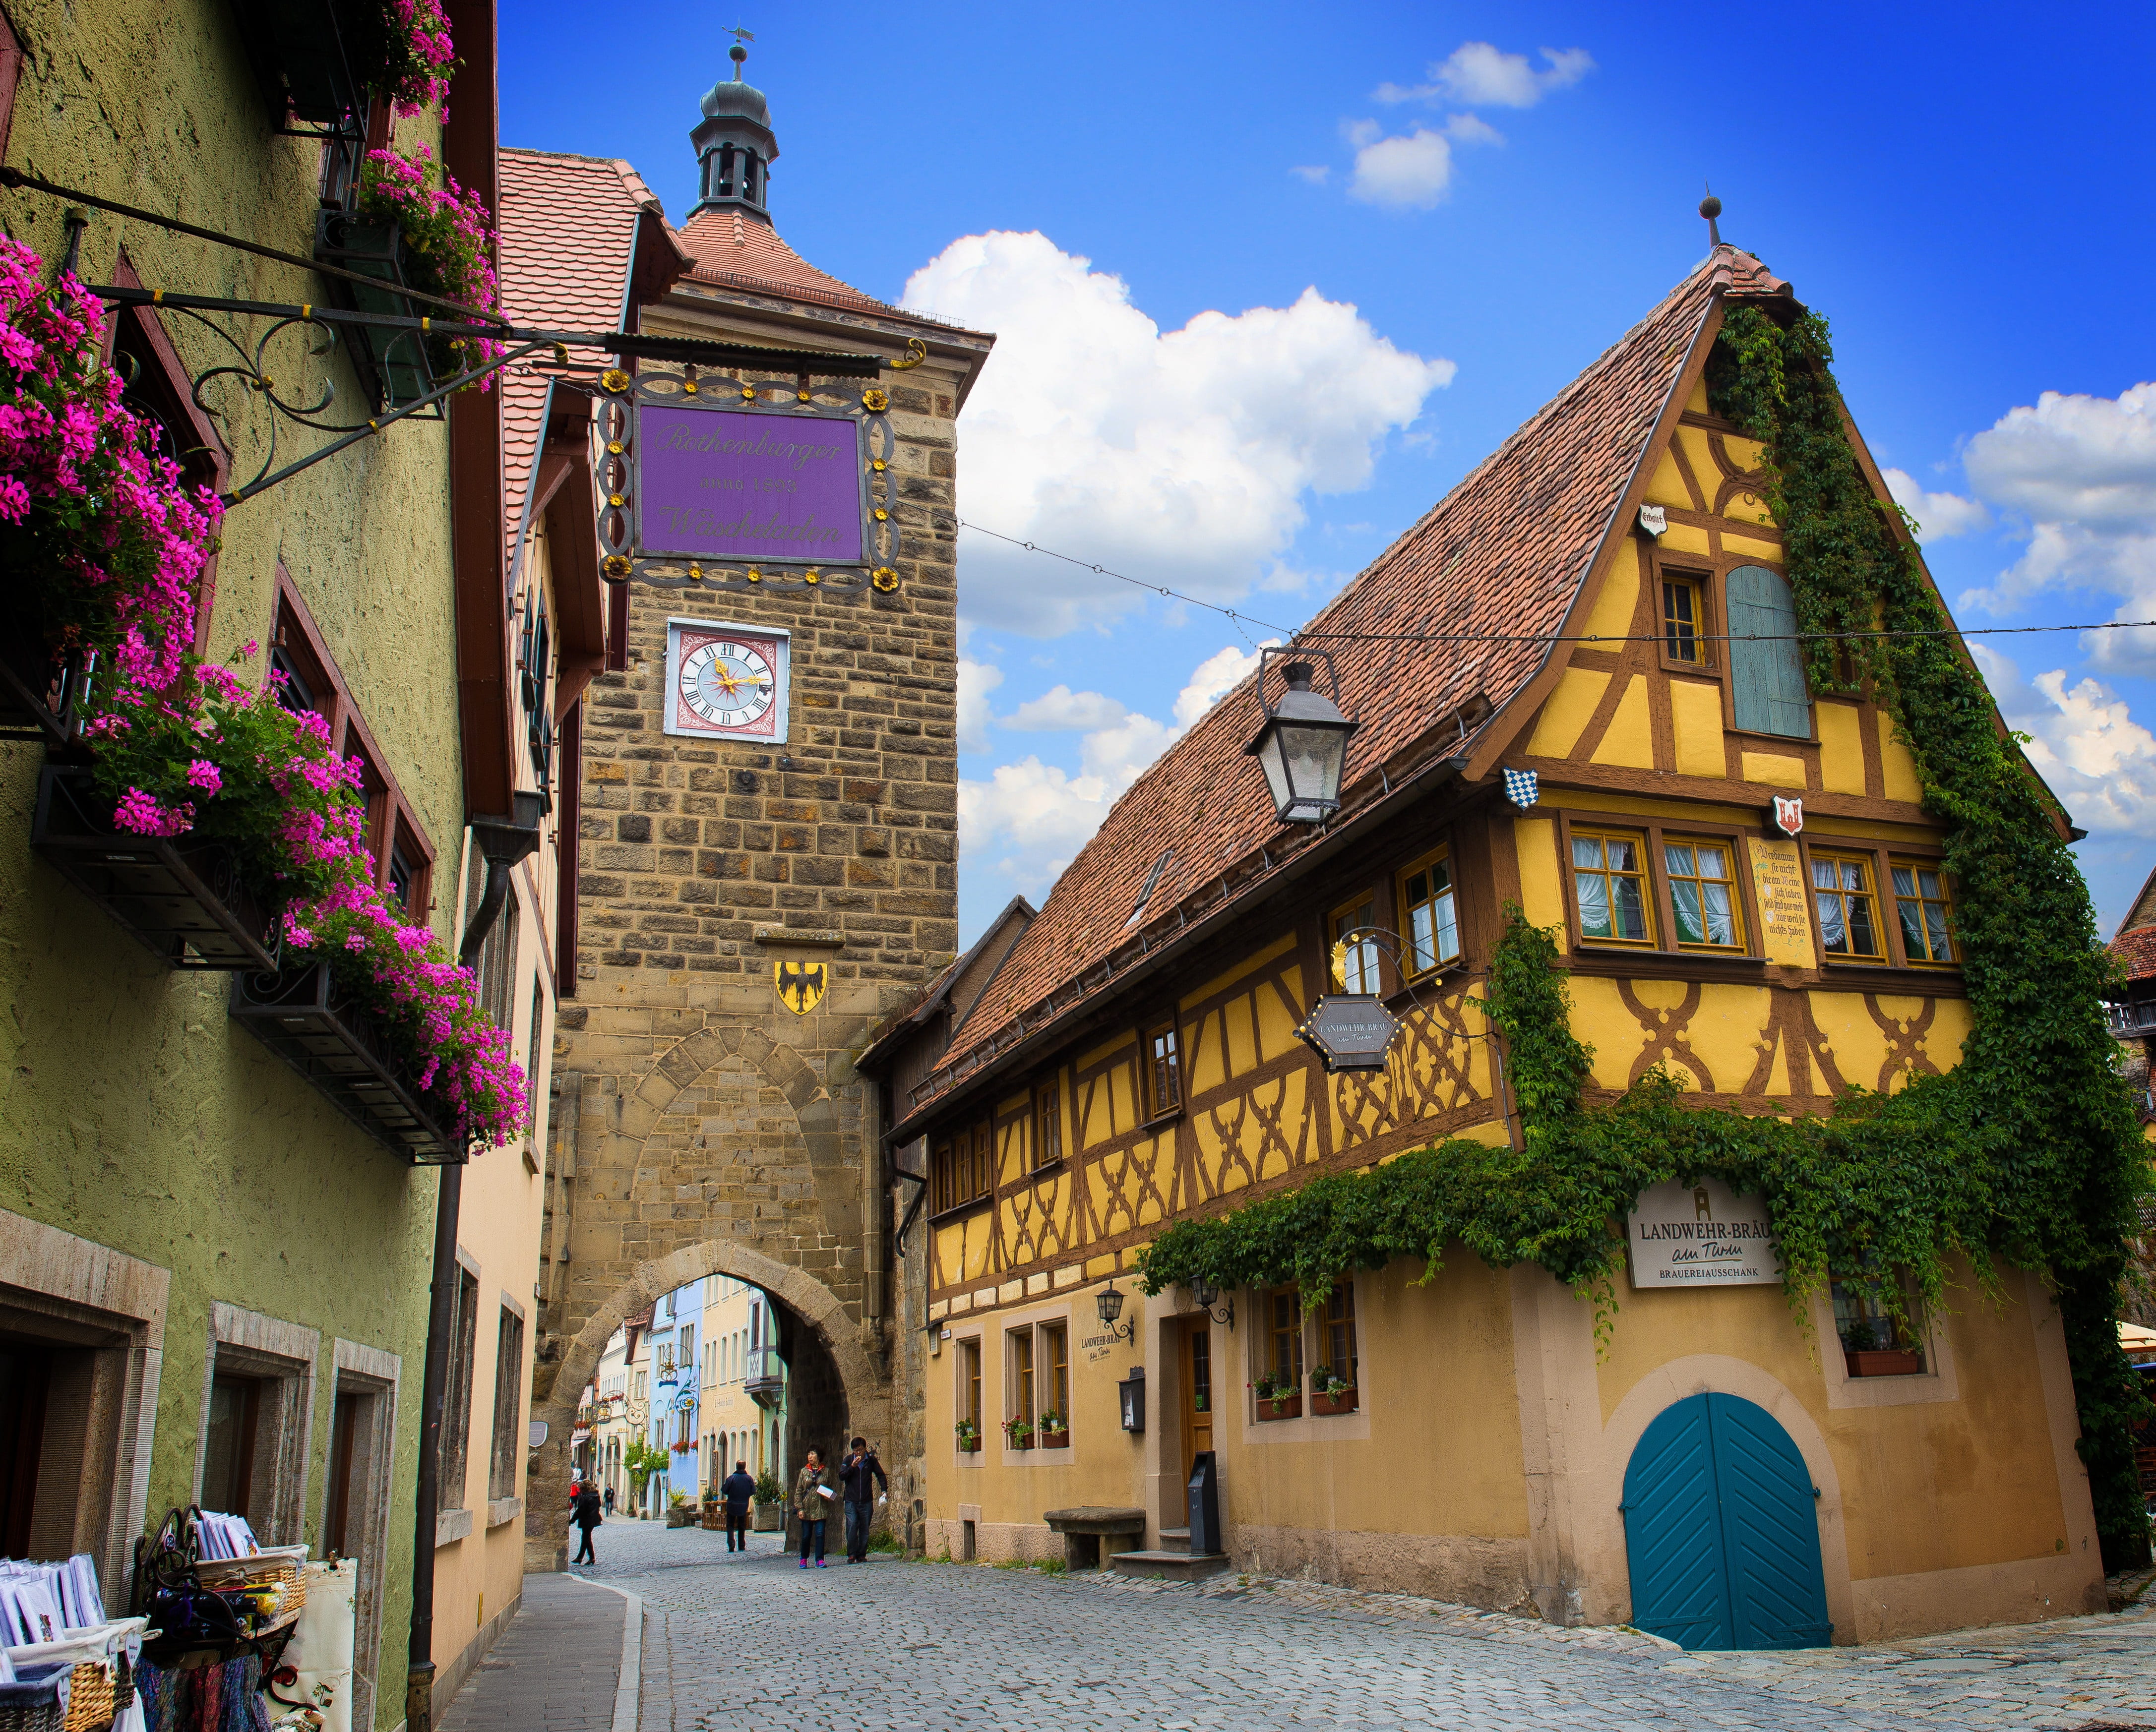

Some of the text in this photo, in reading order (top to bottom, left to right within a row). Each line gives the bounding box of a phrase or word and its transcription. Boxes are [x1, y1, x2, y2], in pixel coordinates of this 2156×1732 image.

[655, 423, 842, 471] Rothenburger
[700, 477, 797, 493] anno 1893
[659, 506, 843, 543] Wäscheladen
[1641, 1219, 1770, 1240] LANDWEHR-BRÄU
[1672, 1241, 1743, 1262] am Turm
[1659, 1267, 1759, 1279] BRAUEREIAUSSCHANK
